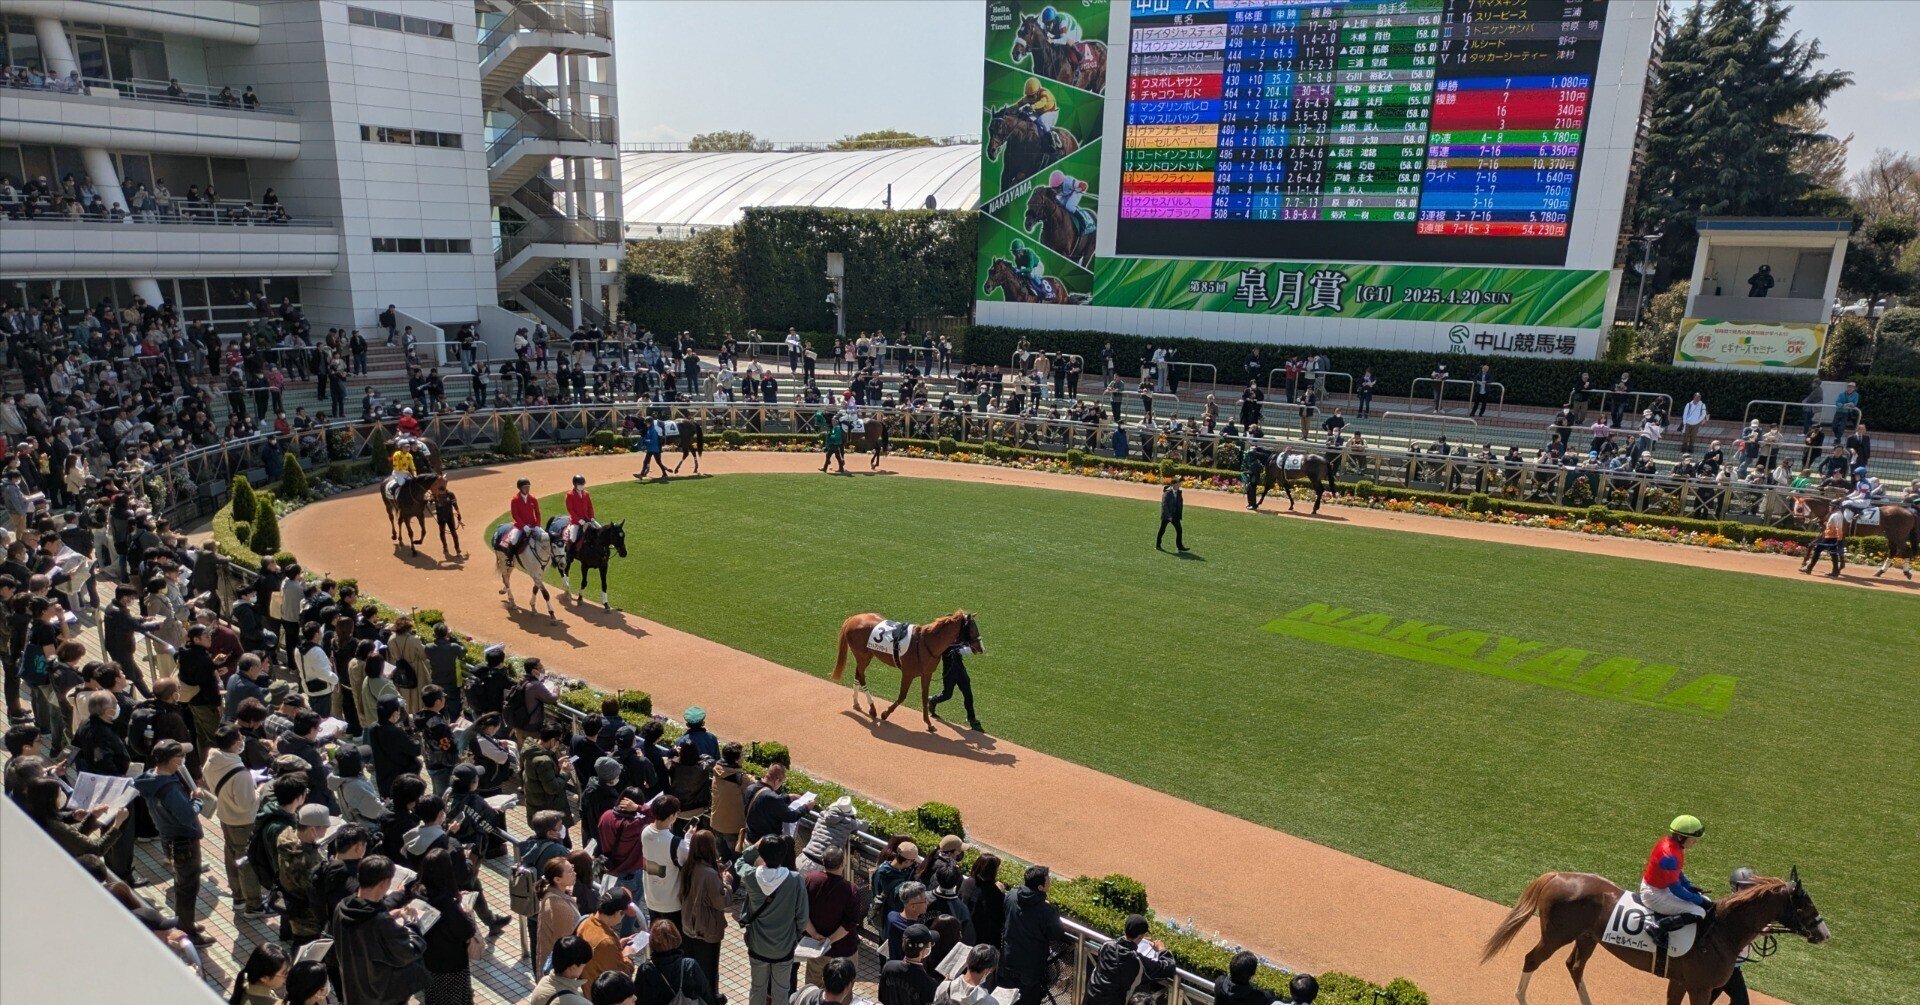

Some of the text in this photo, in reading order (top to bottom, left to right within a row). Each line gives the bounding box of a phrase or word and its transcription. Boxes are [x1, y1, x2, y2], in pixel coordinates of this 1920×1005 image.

[990, 14, 1012, 22] Special
[1173, 14, 1194, 25] 馬名
[1235, 10, 1263, 22] 馬体重
[1462, 13, 1472, 24] 16
[1231, 26, 1244, 36] 502
[1465, 26, 1471, 36] 3
[1229, 38, 1243, 48] 498
[1462, 40, 1468, 50] 2
[1228, 50, 1242, 60] 444
[1456, 54, 1467, 64] 14
[1226, 76, 1240, 86] 430
[1505, 78, 1511, 89] 7
[1225, 88, 1239, 98] 464
[1503, 92, 1509, 102] 7
[1560, 90, 1586, 102] 310円
[1224, 100, 1238, 110] 514
[1496, 104, 1584, 116] 16 340円
[1223, 113, 1236, 122] 474
[1500, 118, 1582, 130] 3 210円
[1222, 125, 1236, 135] 480
[1220, 137, 1234, 146] 446
[1220, 149, 1233, 158] 486
[1480, 146, 1500, 156] 7-16
[1218, 162, 1232, 170] 560
[1478, 159, 1499, 169] 7-16
[1218, 173, 1231, 183] 494
[1426, 172, 1456, 182] ワイド
[1476, 172, 1497, 182] 7-16
[1216, 186, 1230, 195] 490
[1544, 185, 1570, 196] 760円
[988, 181, 1032, 214] NAKAYAMA
[1215, 197, 1229, 207] 462
[1473, 198, 1568, 209] 3-16 790円
[1214, 209, 1228, 218] 508
[1042, 280, 1053, 293] 8
[1188, 280, 1227, 294] 第85回
[1234, 268, 1348, 313] 皐月賞
[1403, 287, 1480, 305] 2025.4.20
[1483, 292, 1512, 304] SUN
[1474, 331, 1578, 355] 中山競馬場
[1447, 344, 1468, 355] JRA
[1787, 345, 1802, 354] OK
[1868, 510, 1877, 520] 7
[873, 626, 886, 643] 3
[1282, 602, 1739, 715] NAKAYAMA
[1612, 904, 1646, 936] 10
